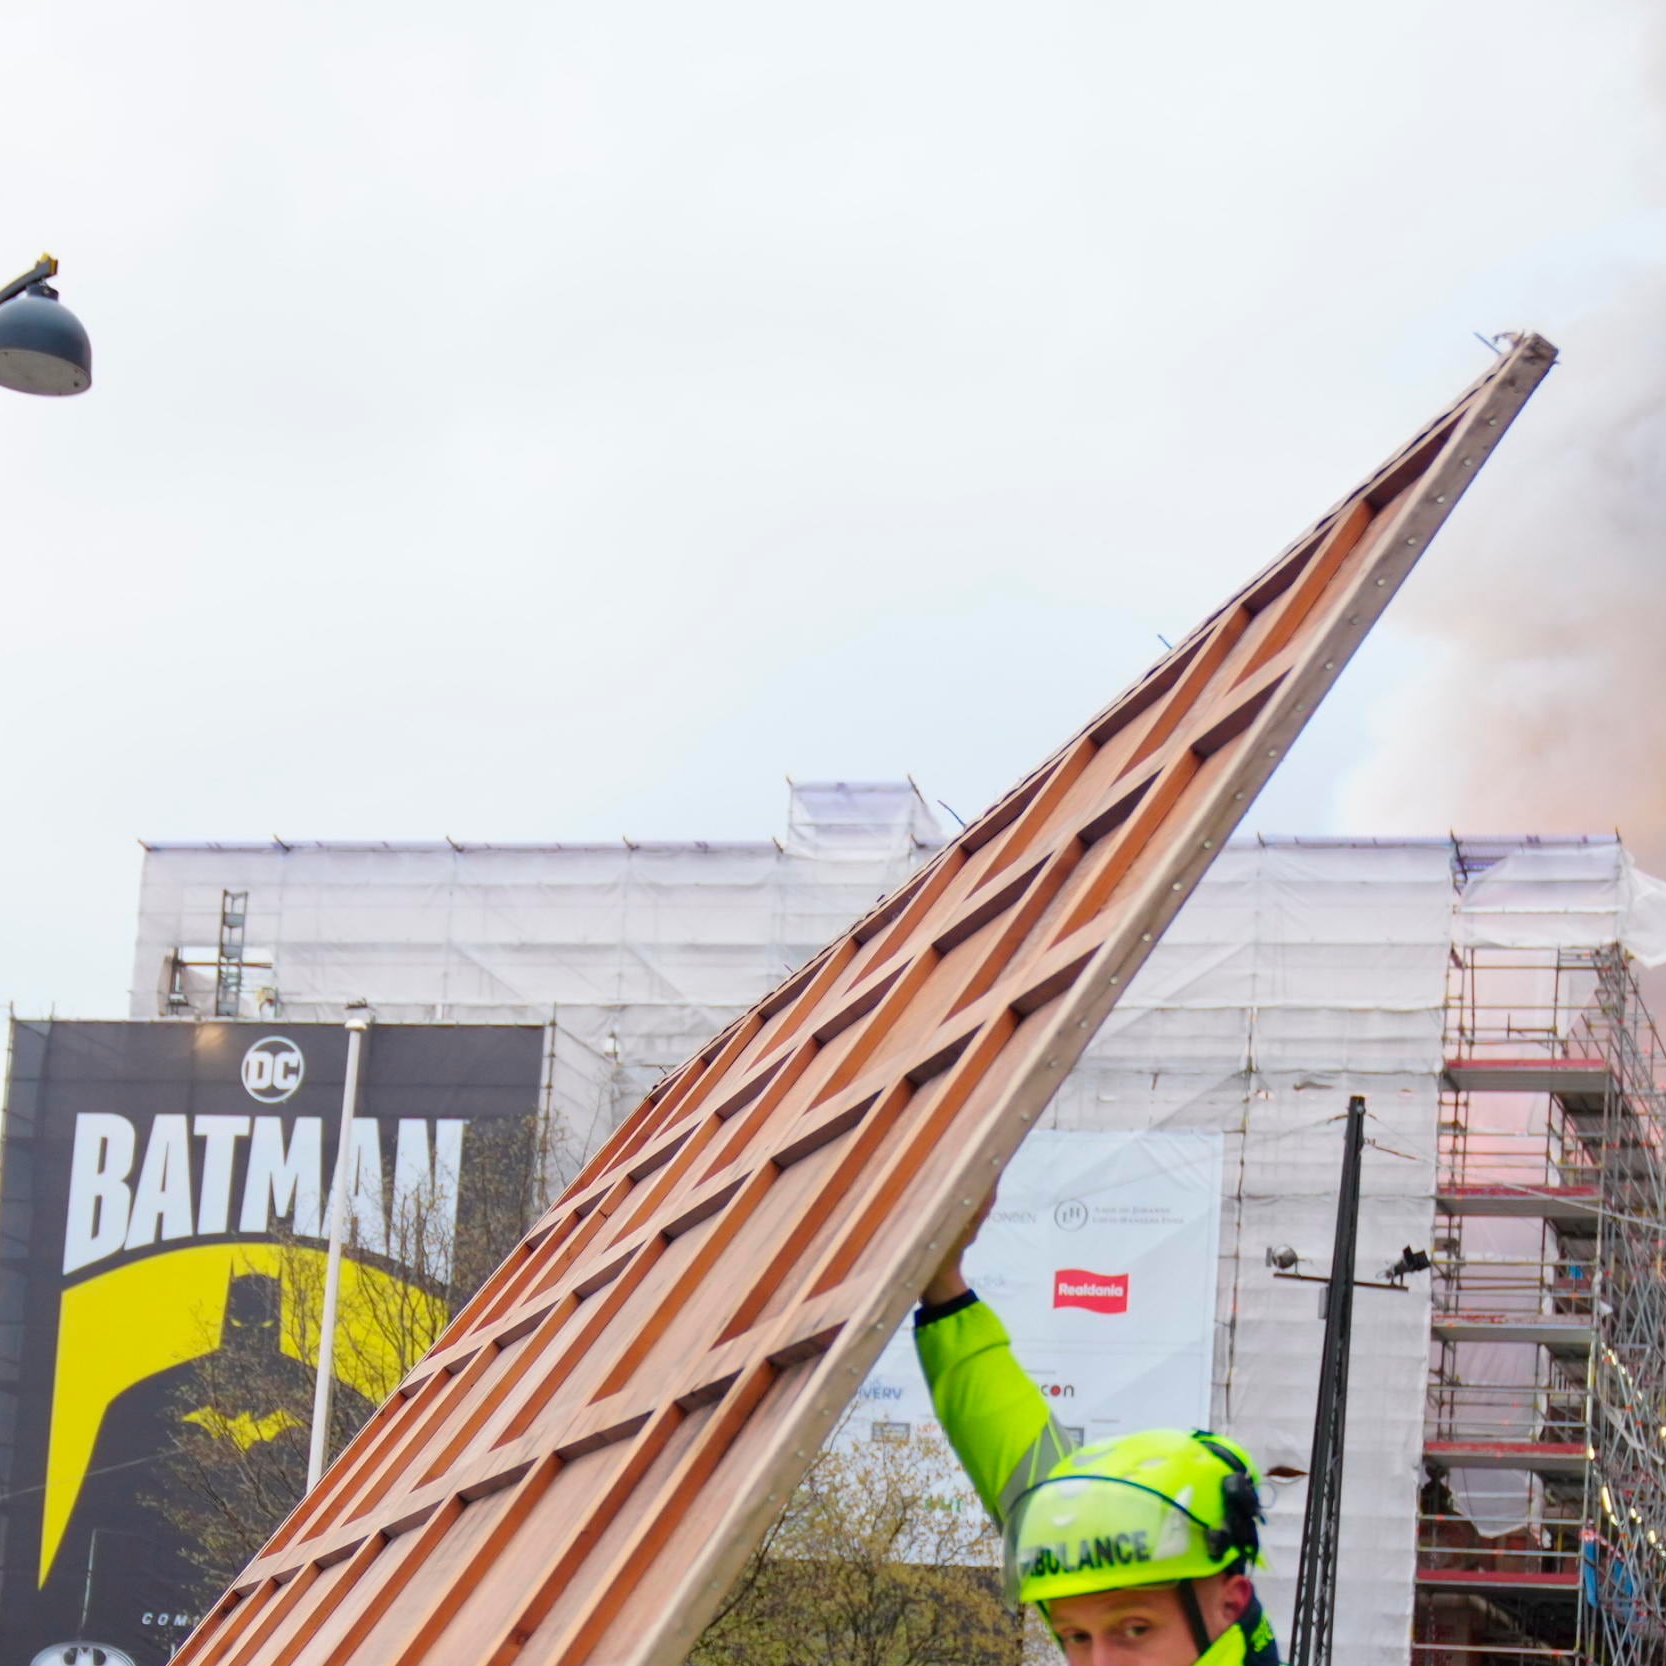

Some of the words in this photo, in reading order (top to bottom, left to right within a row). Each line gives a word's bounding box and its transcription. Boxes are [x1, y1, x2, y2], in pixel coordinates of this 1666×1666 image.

[246, 1050, 301, 1090] DC
[62, 1111, 467, 1286] BATMAN
[1058, 1282, 1124, 1298] Realdania
